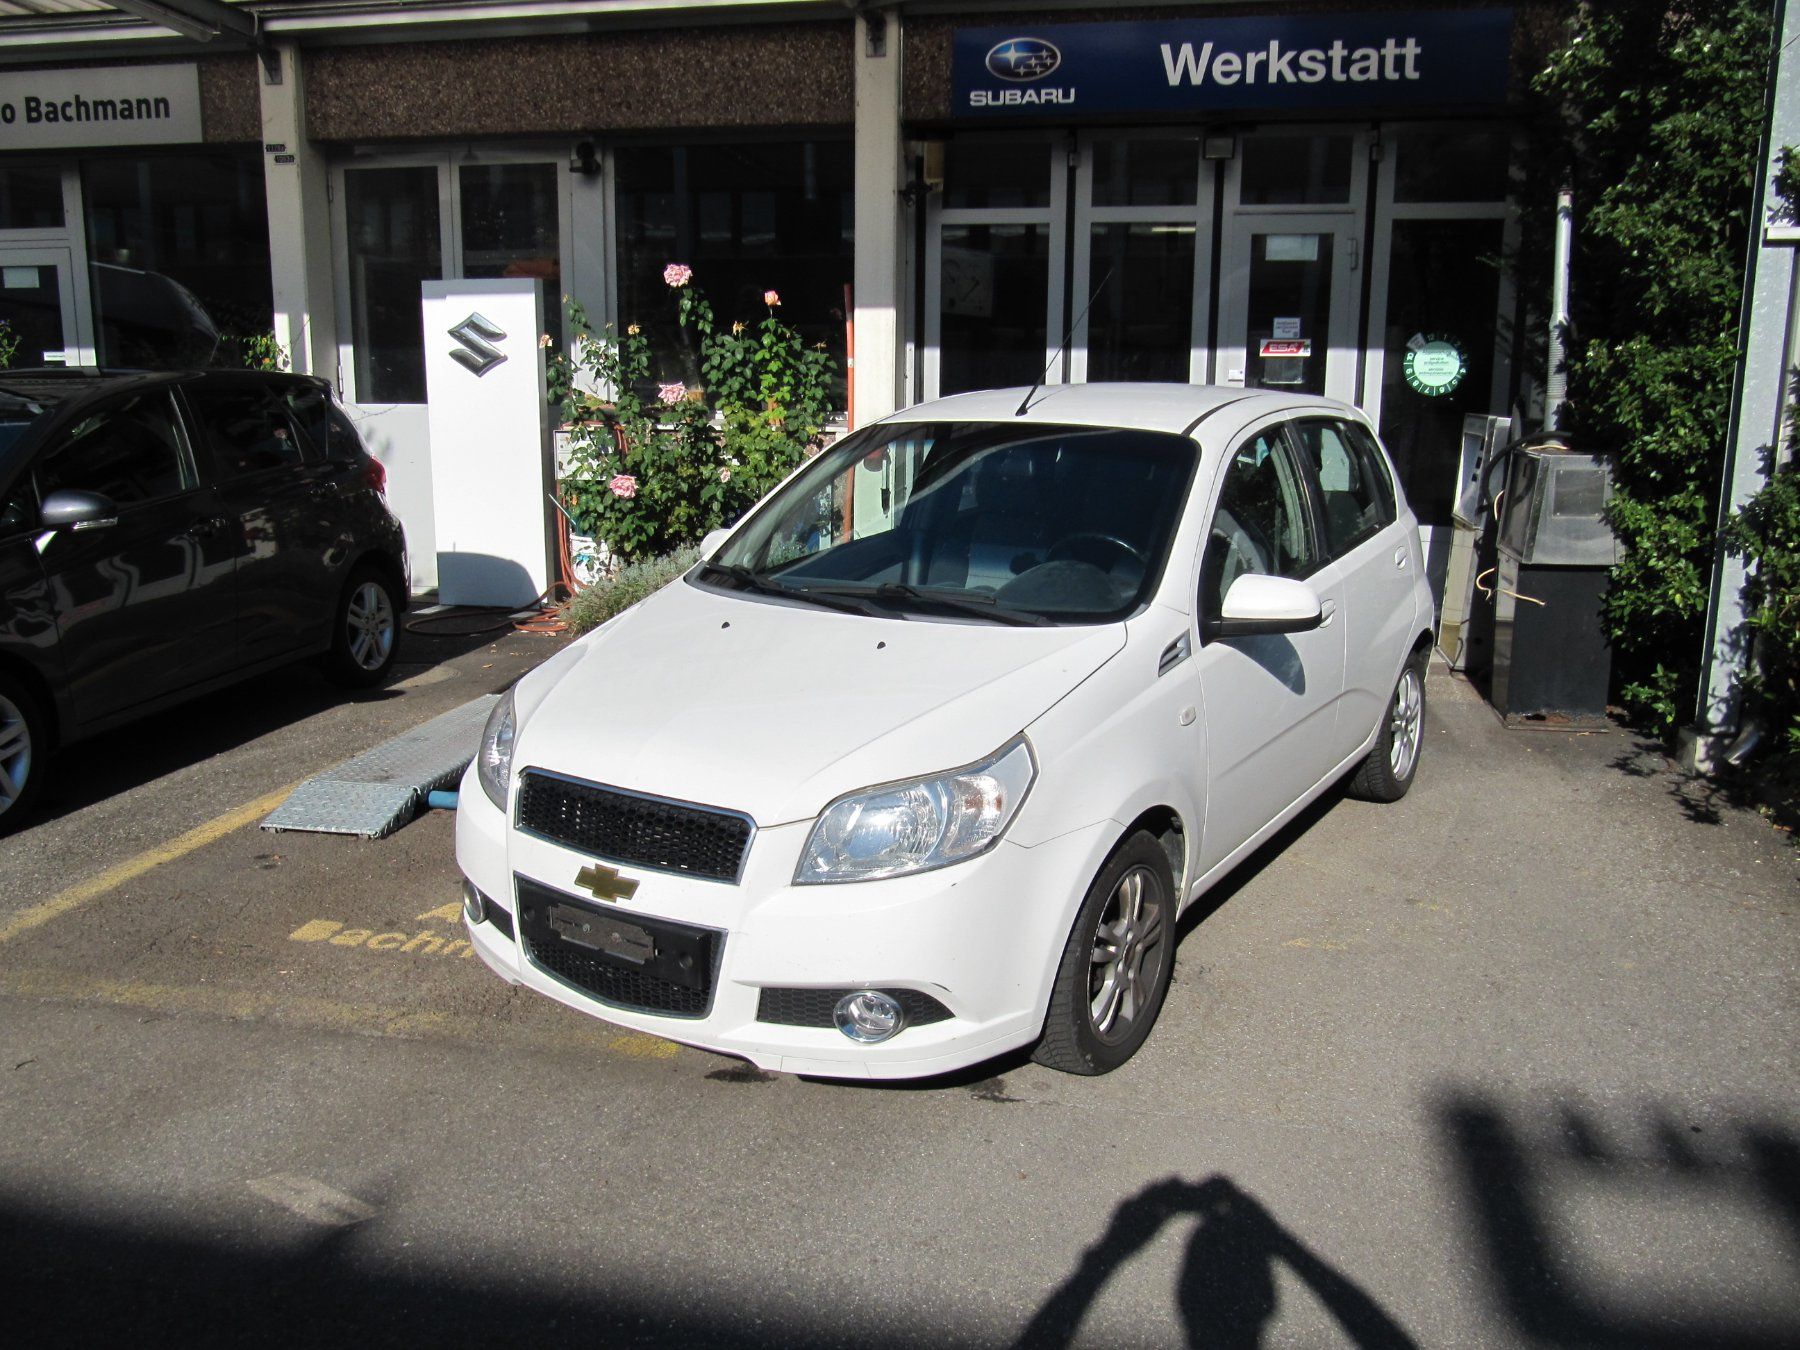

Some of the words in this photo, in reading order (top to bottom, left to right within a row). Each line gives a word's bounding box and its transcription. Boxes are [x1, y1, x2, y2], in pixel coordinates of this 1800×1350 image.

[1160, 37, 1422, 87] Werkstatt
[24, 94, 171, 124] Bachmann
[969, 88, 1075, 107] SUBARU
